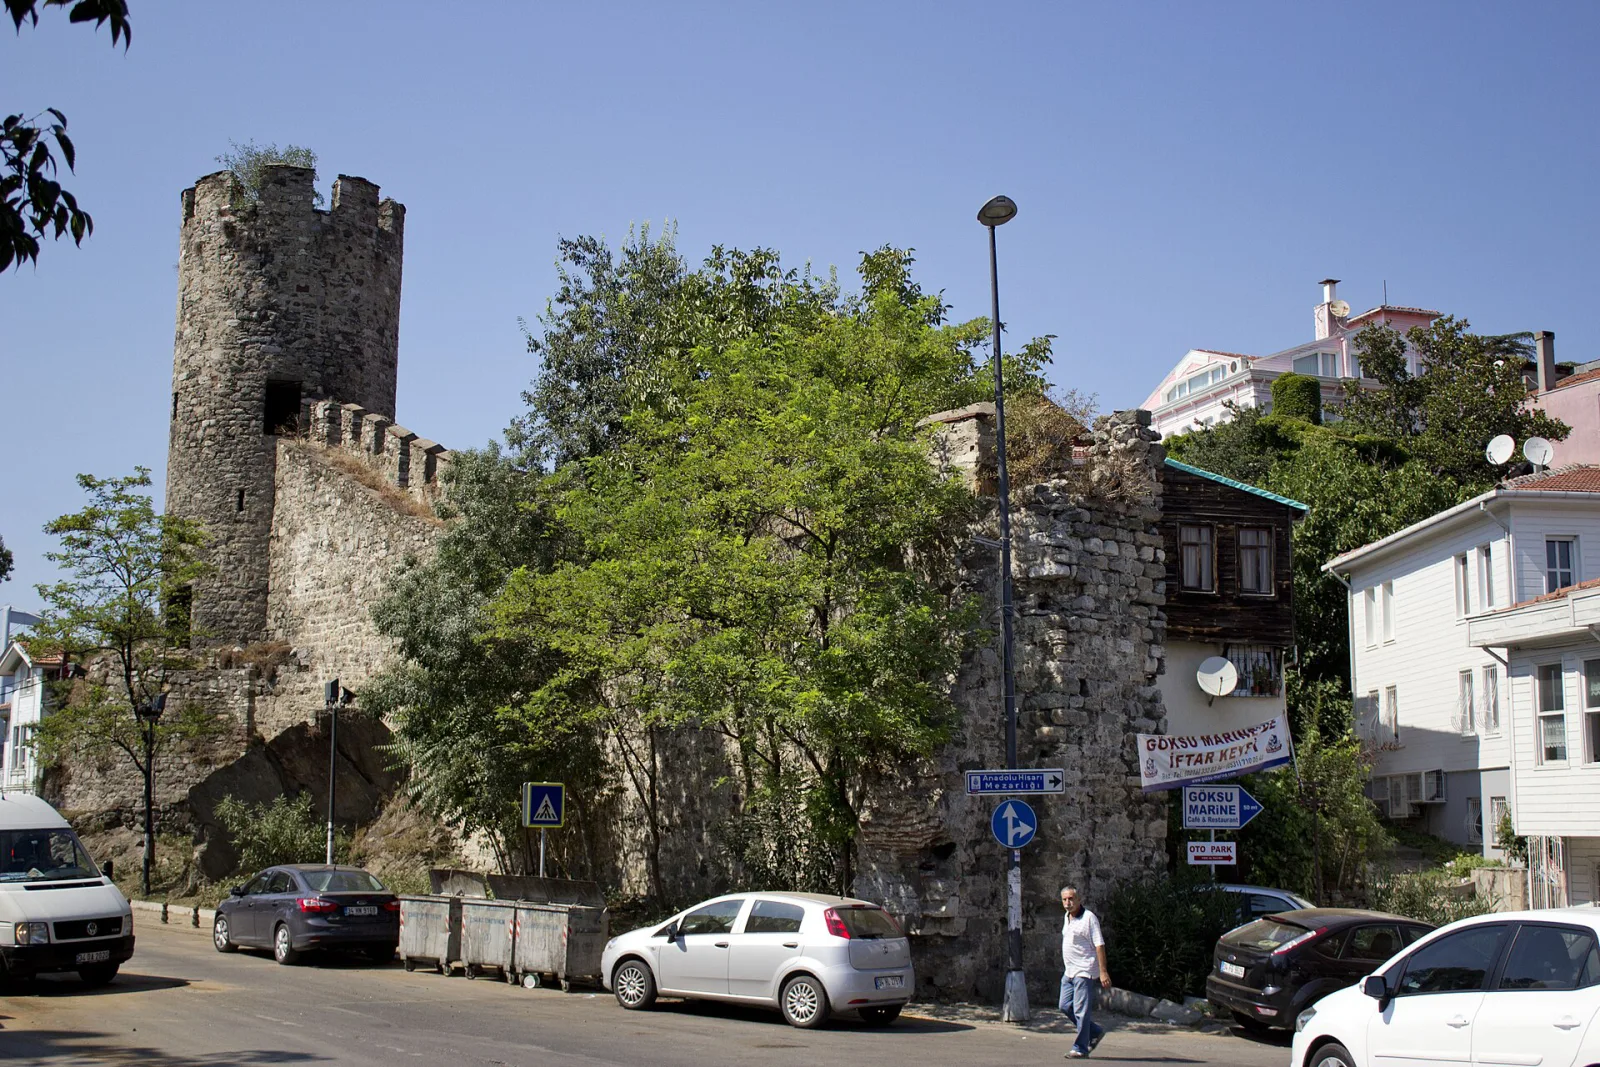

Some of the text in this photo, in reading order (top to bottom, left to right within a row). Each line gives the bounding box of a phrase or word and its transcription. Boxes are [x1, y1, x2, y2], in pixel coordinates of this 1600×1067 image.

[1146, 735, 1198, 751] GÖKSU
[1169, 738, 1258, 769] İFTAR KEYFİ
[985, 782, 1041, 790] Mezarlığı
[1188, 789, 1234, 802] GÖKSU
[1189, 845, 1232, 853] OTO PARK
